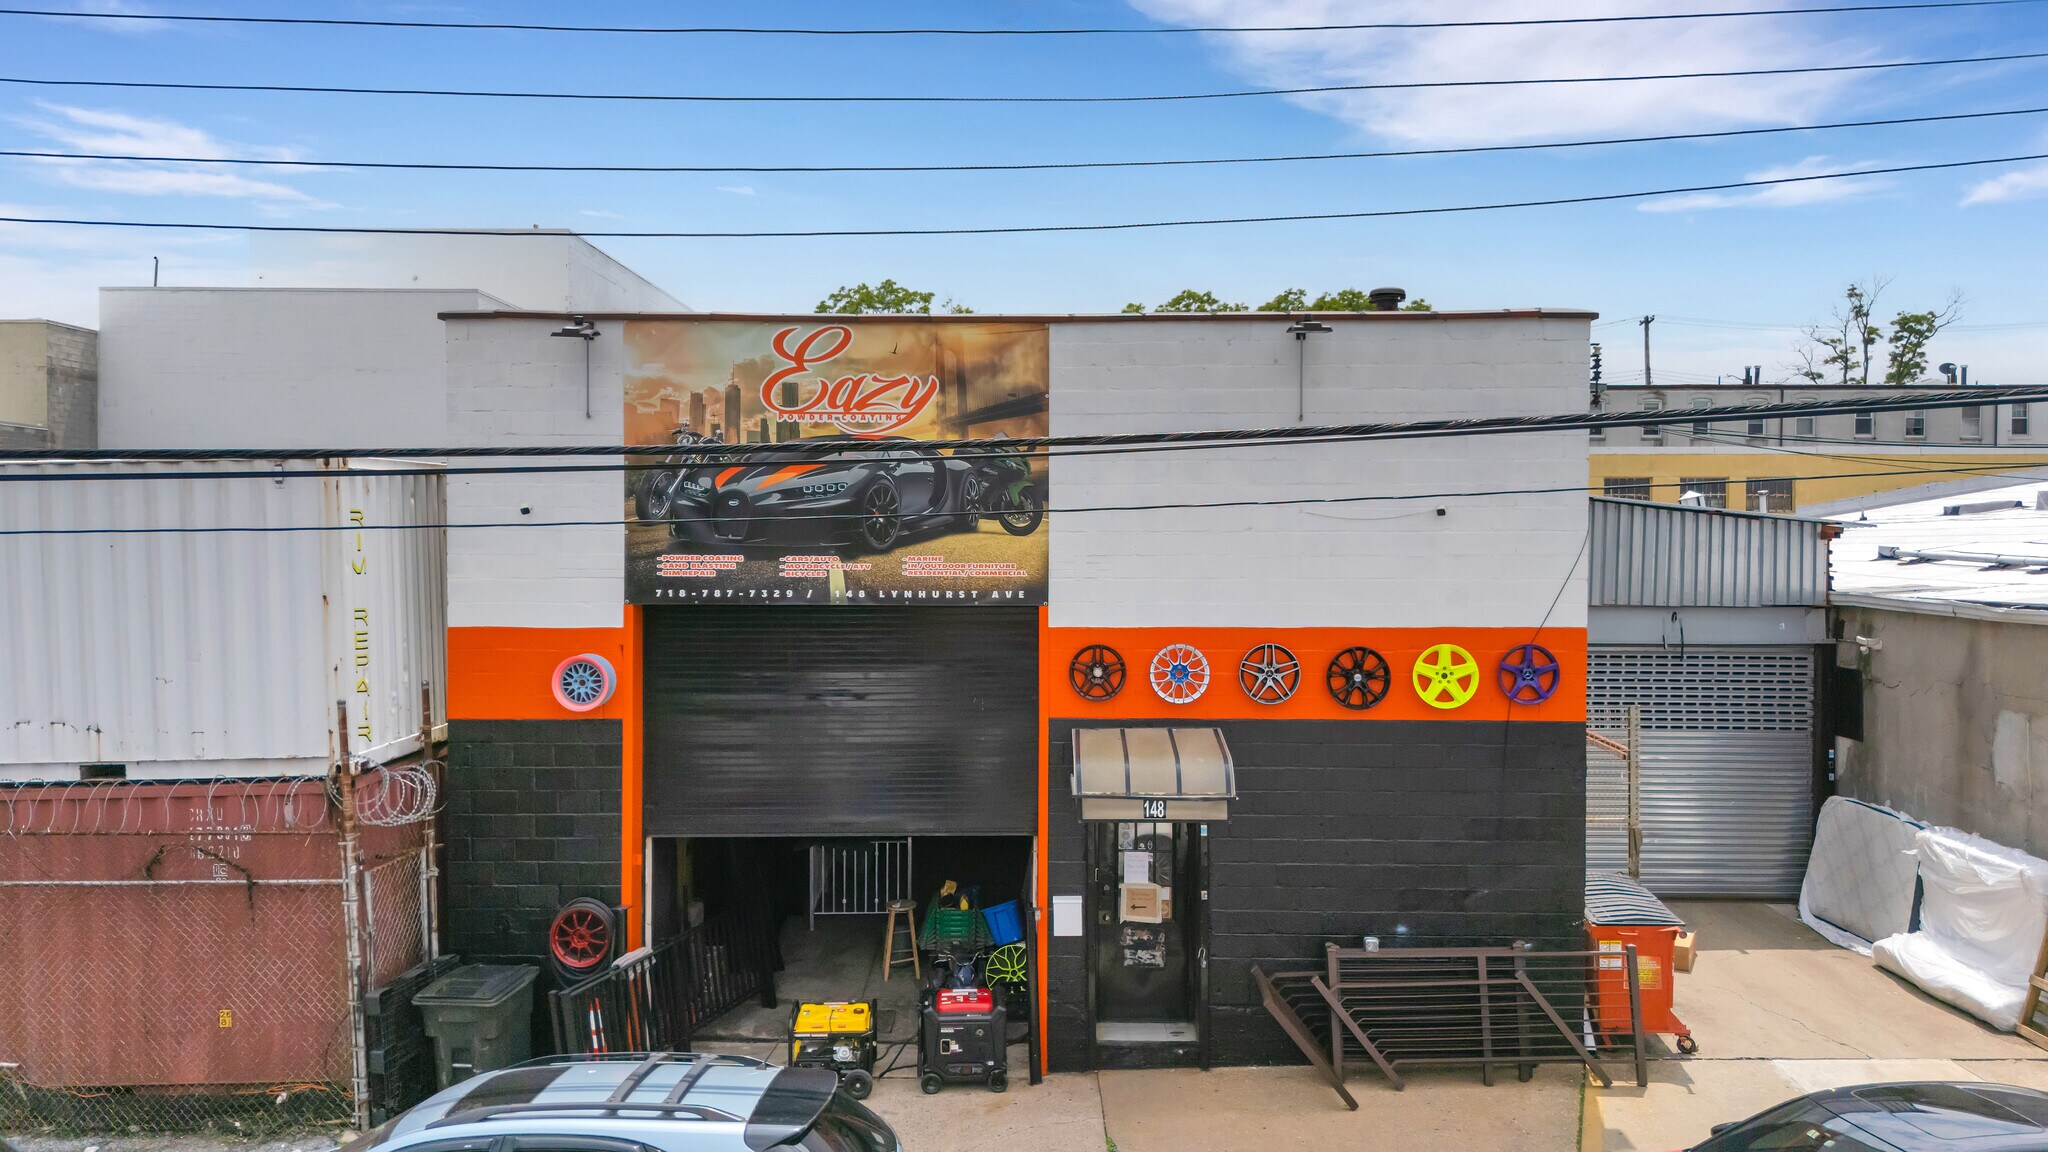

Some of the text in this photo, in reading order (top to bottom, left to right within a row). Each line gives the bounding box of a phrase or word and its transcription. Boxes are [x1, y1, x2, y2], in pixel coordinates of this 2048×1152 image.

[760, 324, 939, 434] Eazy
[777, 413, 903, 422] POWDER COATING
[656, 589, 793, 598] 718-787-7329
[834, 590, 865, 598] 148
[879, 590, 978, 599] LYNHURST
[991, 590, 1025, 599] AVE
[354, 607, 372, 743] REPAIR
[1143, 800, 1165, 818] 148
